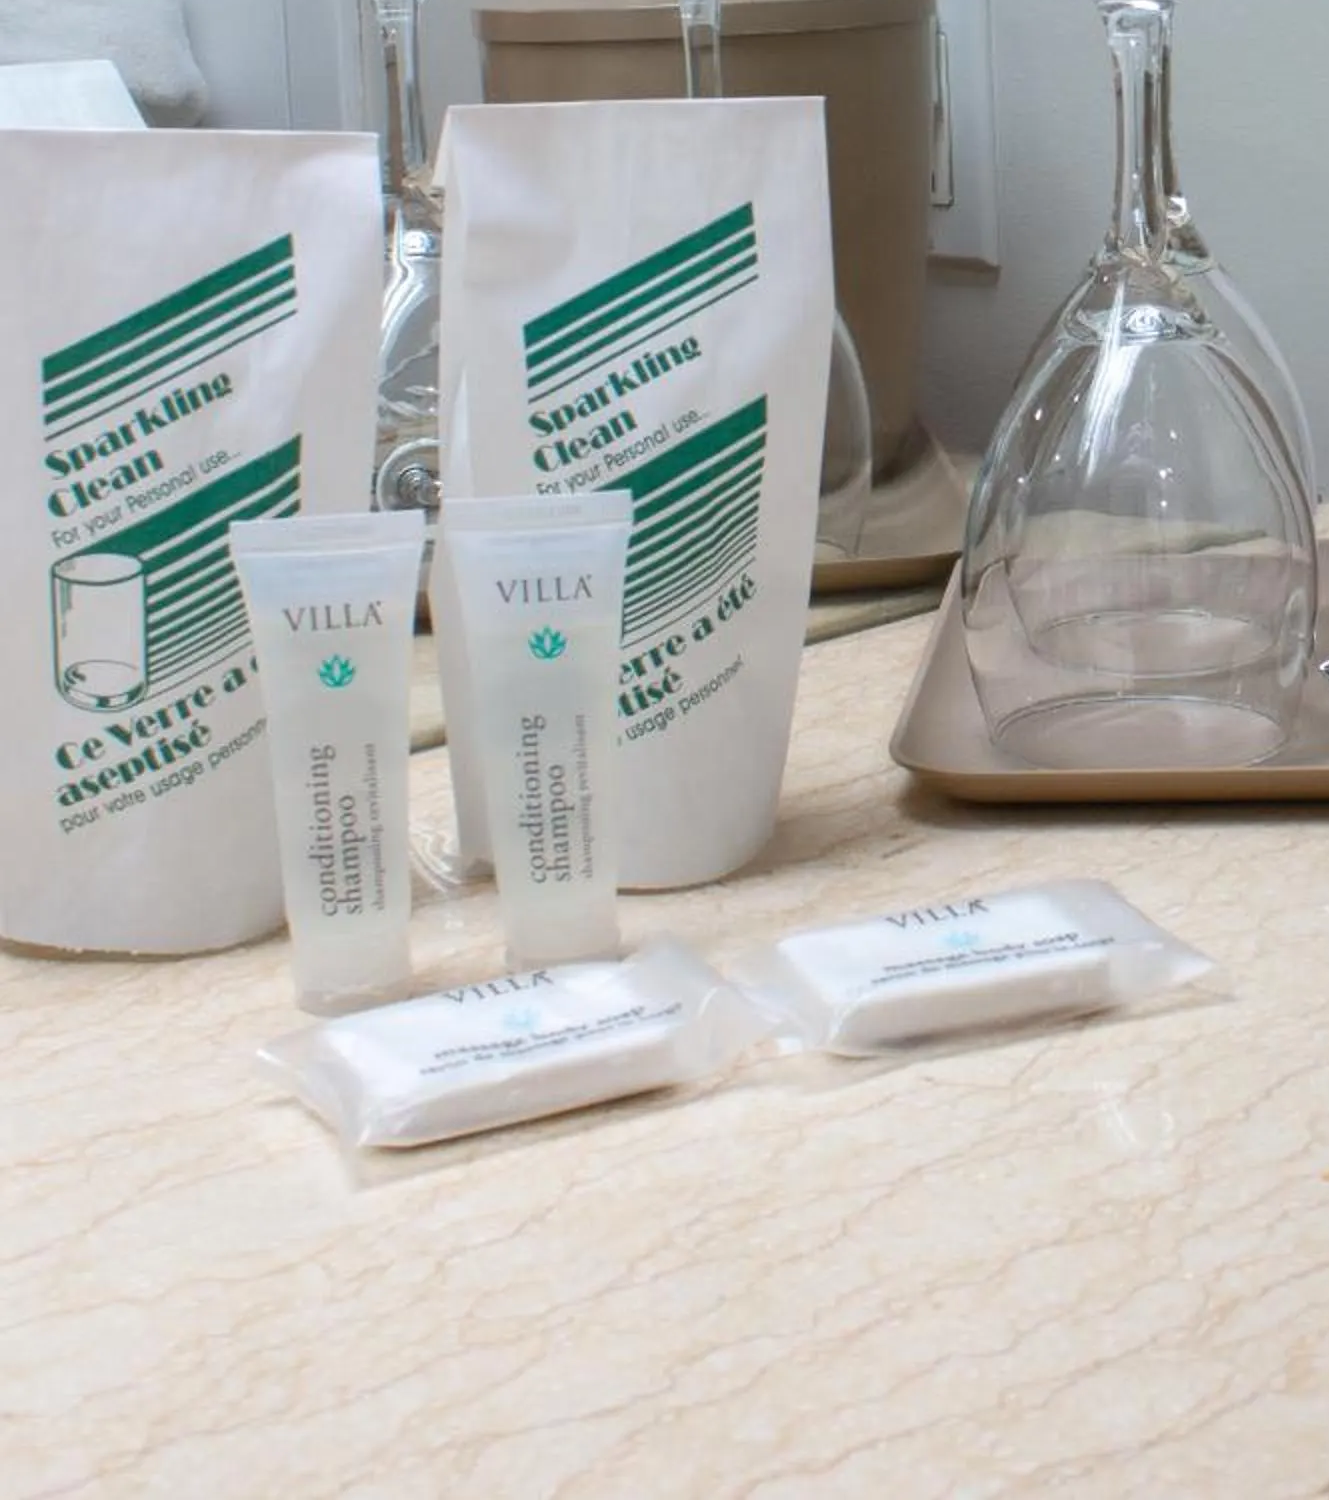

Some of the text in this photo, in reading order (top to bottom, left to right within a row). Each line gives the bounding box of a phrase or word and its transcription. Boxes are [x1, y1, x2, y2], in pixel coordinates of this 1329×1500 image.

[44, 372, 234, 479] Sparkling
[528, 336, 702, 437] Sparkling
[48, 449, 164, 517] Clean
[533, 410, 638, 472] Clean
[564, 464, 601, 494] your
[603, 423, 670, 471] Personal
[51, 526, 80, 548] For
[83, 505, 123, 536] your
[125, 464, 198, 513] Personal
[619, 572, 757, 685] erre a été
[55, 667, 247, 771] Ce Verre a
[618, 666, 683, 717] tisé
[625, 706, 675, 741] usage
[56, 719, 212, 807] aseptisé
[60, 717, 268, 835] pour votre usage personn
[516, 714, 545, 885] conditioning
[307, 744, 338, 917] conditioning
[338, 795, 367, 915] shampoo
[546, 764, 575, 882] shampoo
